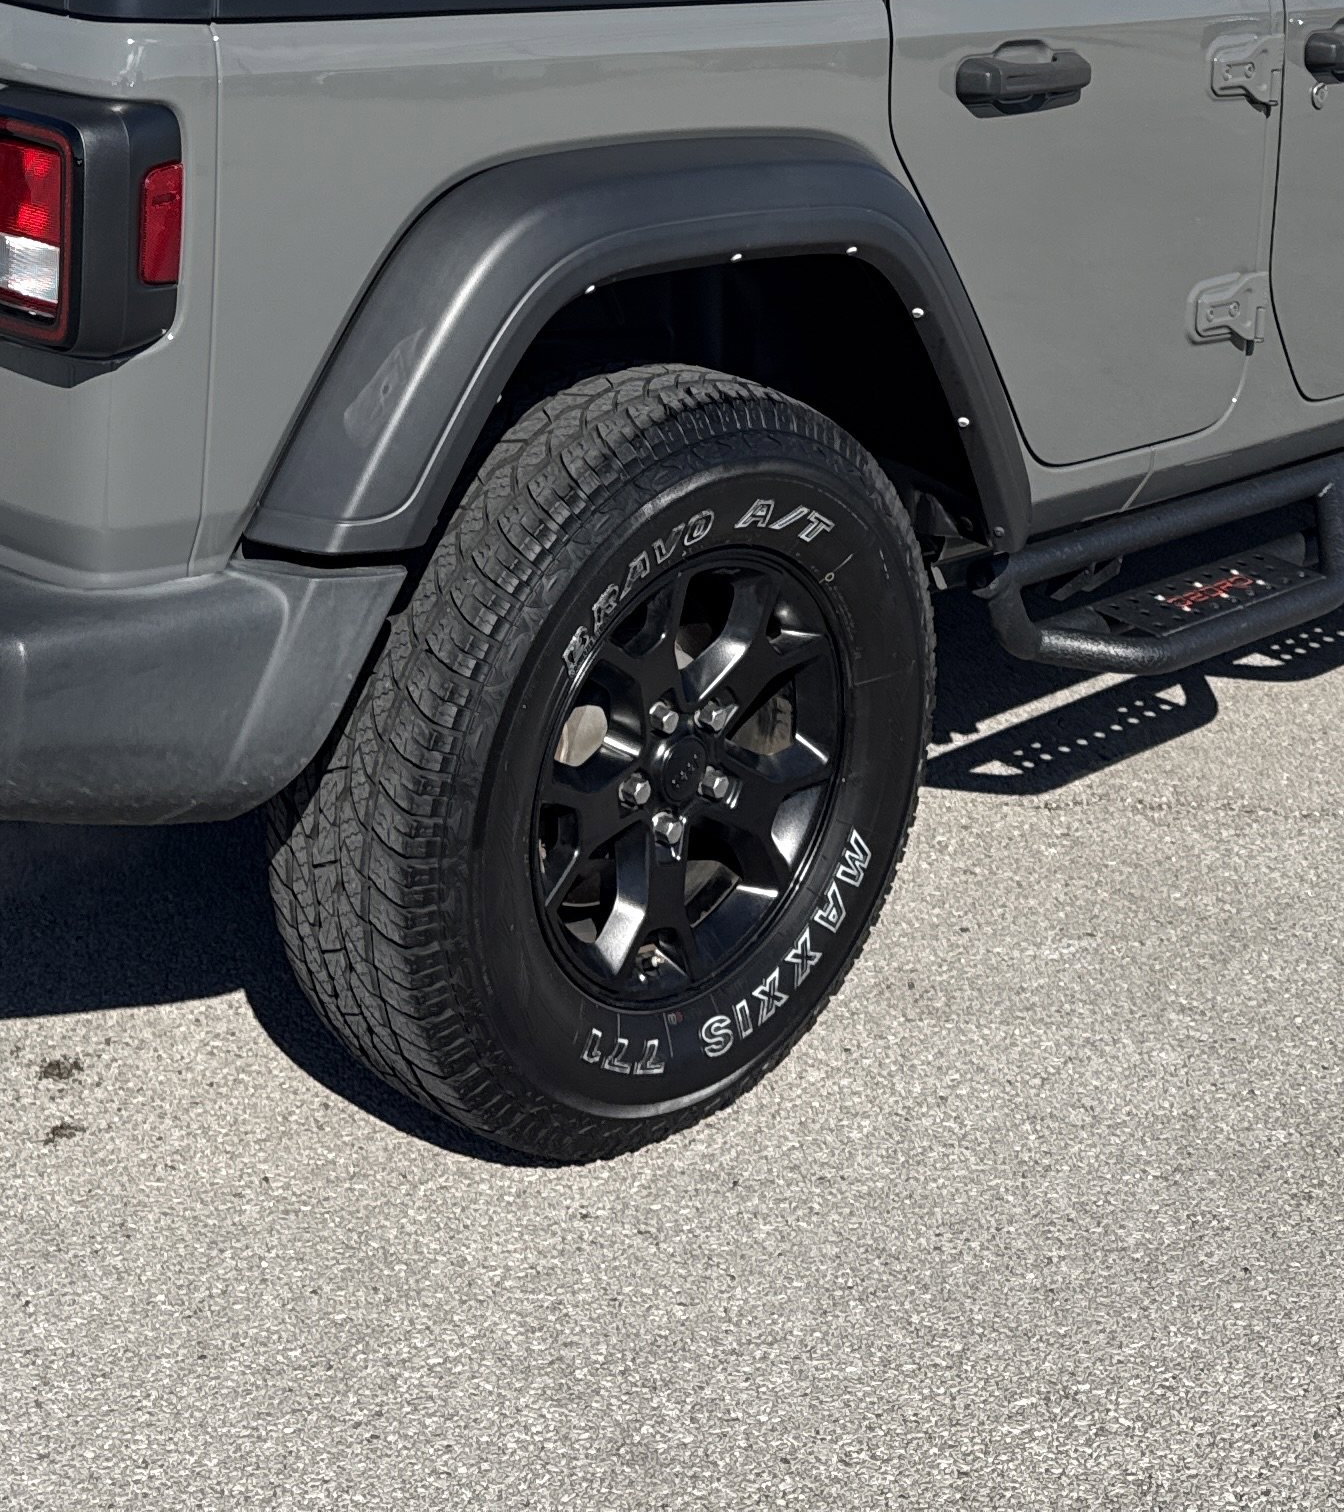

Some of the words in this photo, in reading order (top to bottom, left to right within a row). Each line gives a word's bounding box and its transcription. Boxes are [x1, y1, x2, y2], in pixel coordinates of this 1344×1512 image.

[734, 498, 836, 543] A/T
[699, 829, 873, 1058] MAXXIS
[580, 1027, 665, 1075] 771
